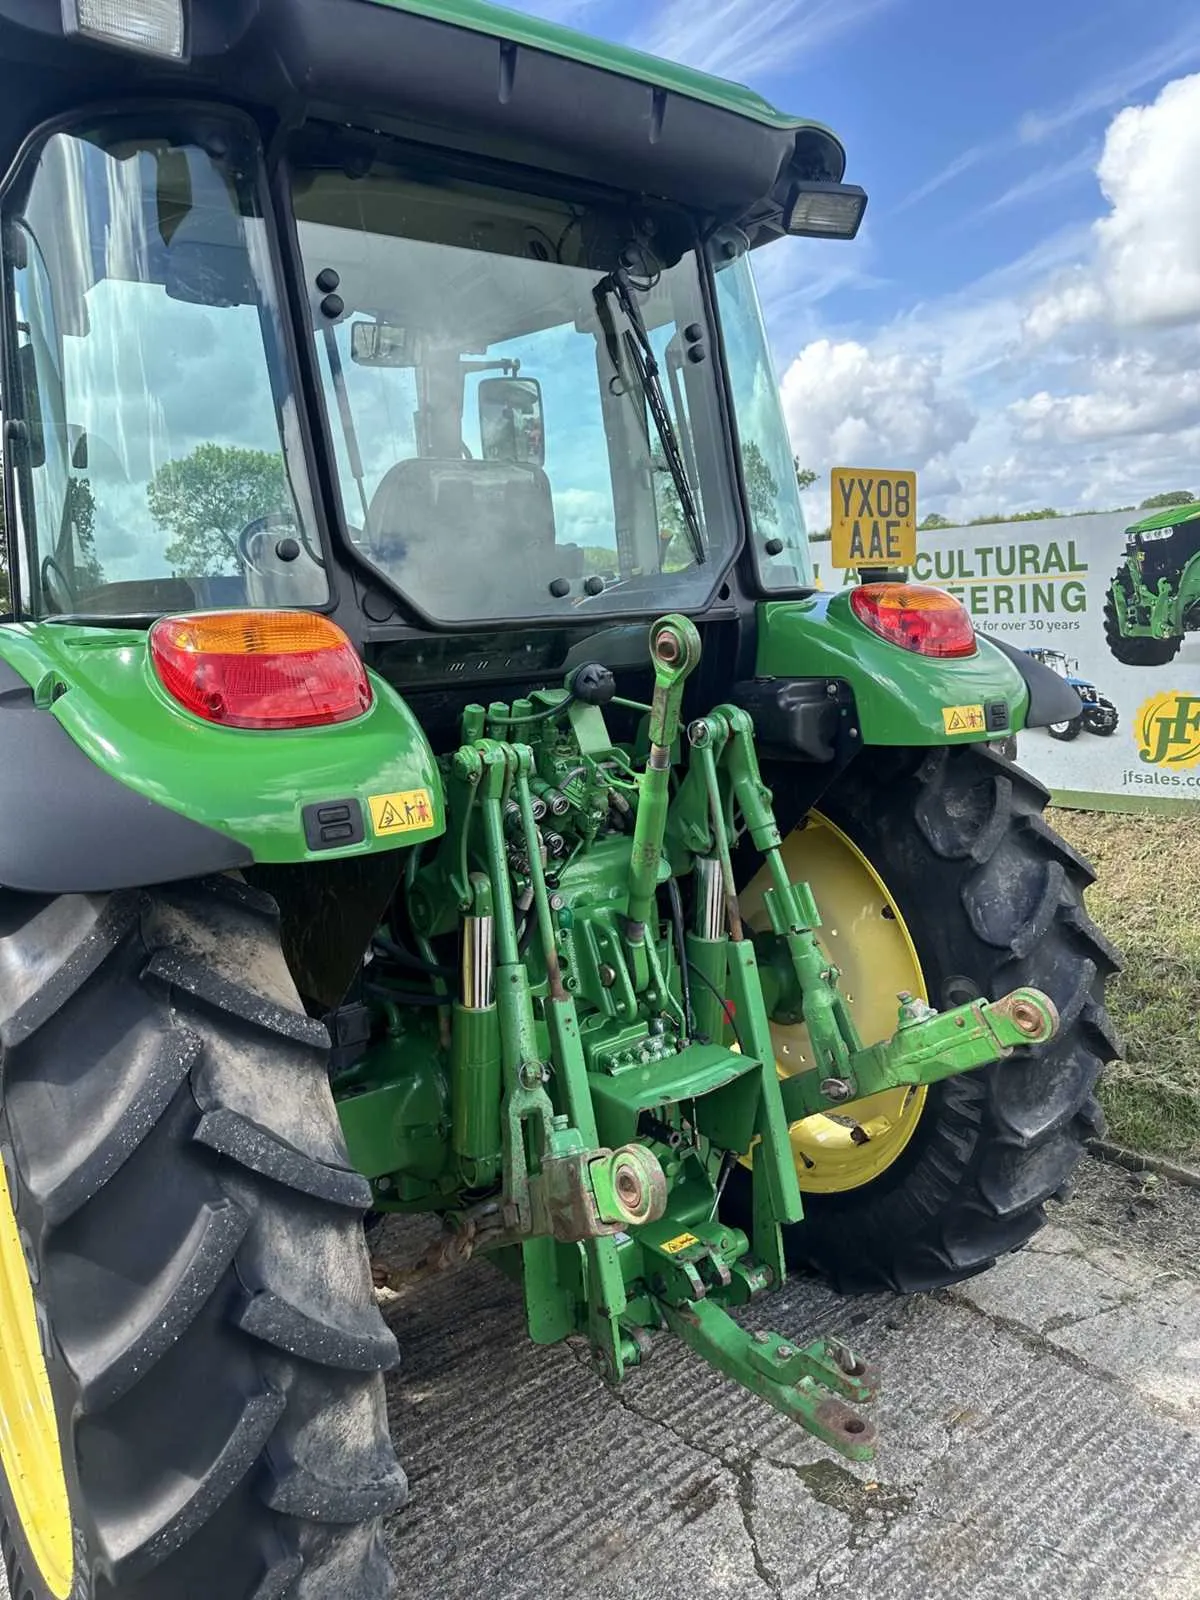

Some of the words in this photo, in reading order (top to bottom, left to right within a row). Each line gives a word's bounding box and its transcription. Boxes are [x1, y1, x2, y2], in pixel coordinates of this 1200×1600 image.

[839, 478, 910, 518] YX08
[849, 520, 902, 559] AAE
[983, 620, 999, 631] for
[1001, 621, 1026, 631] over
[1029, 619, 1044, 631] 30
[1047, 620, 1080, 633] years
